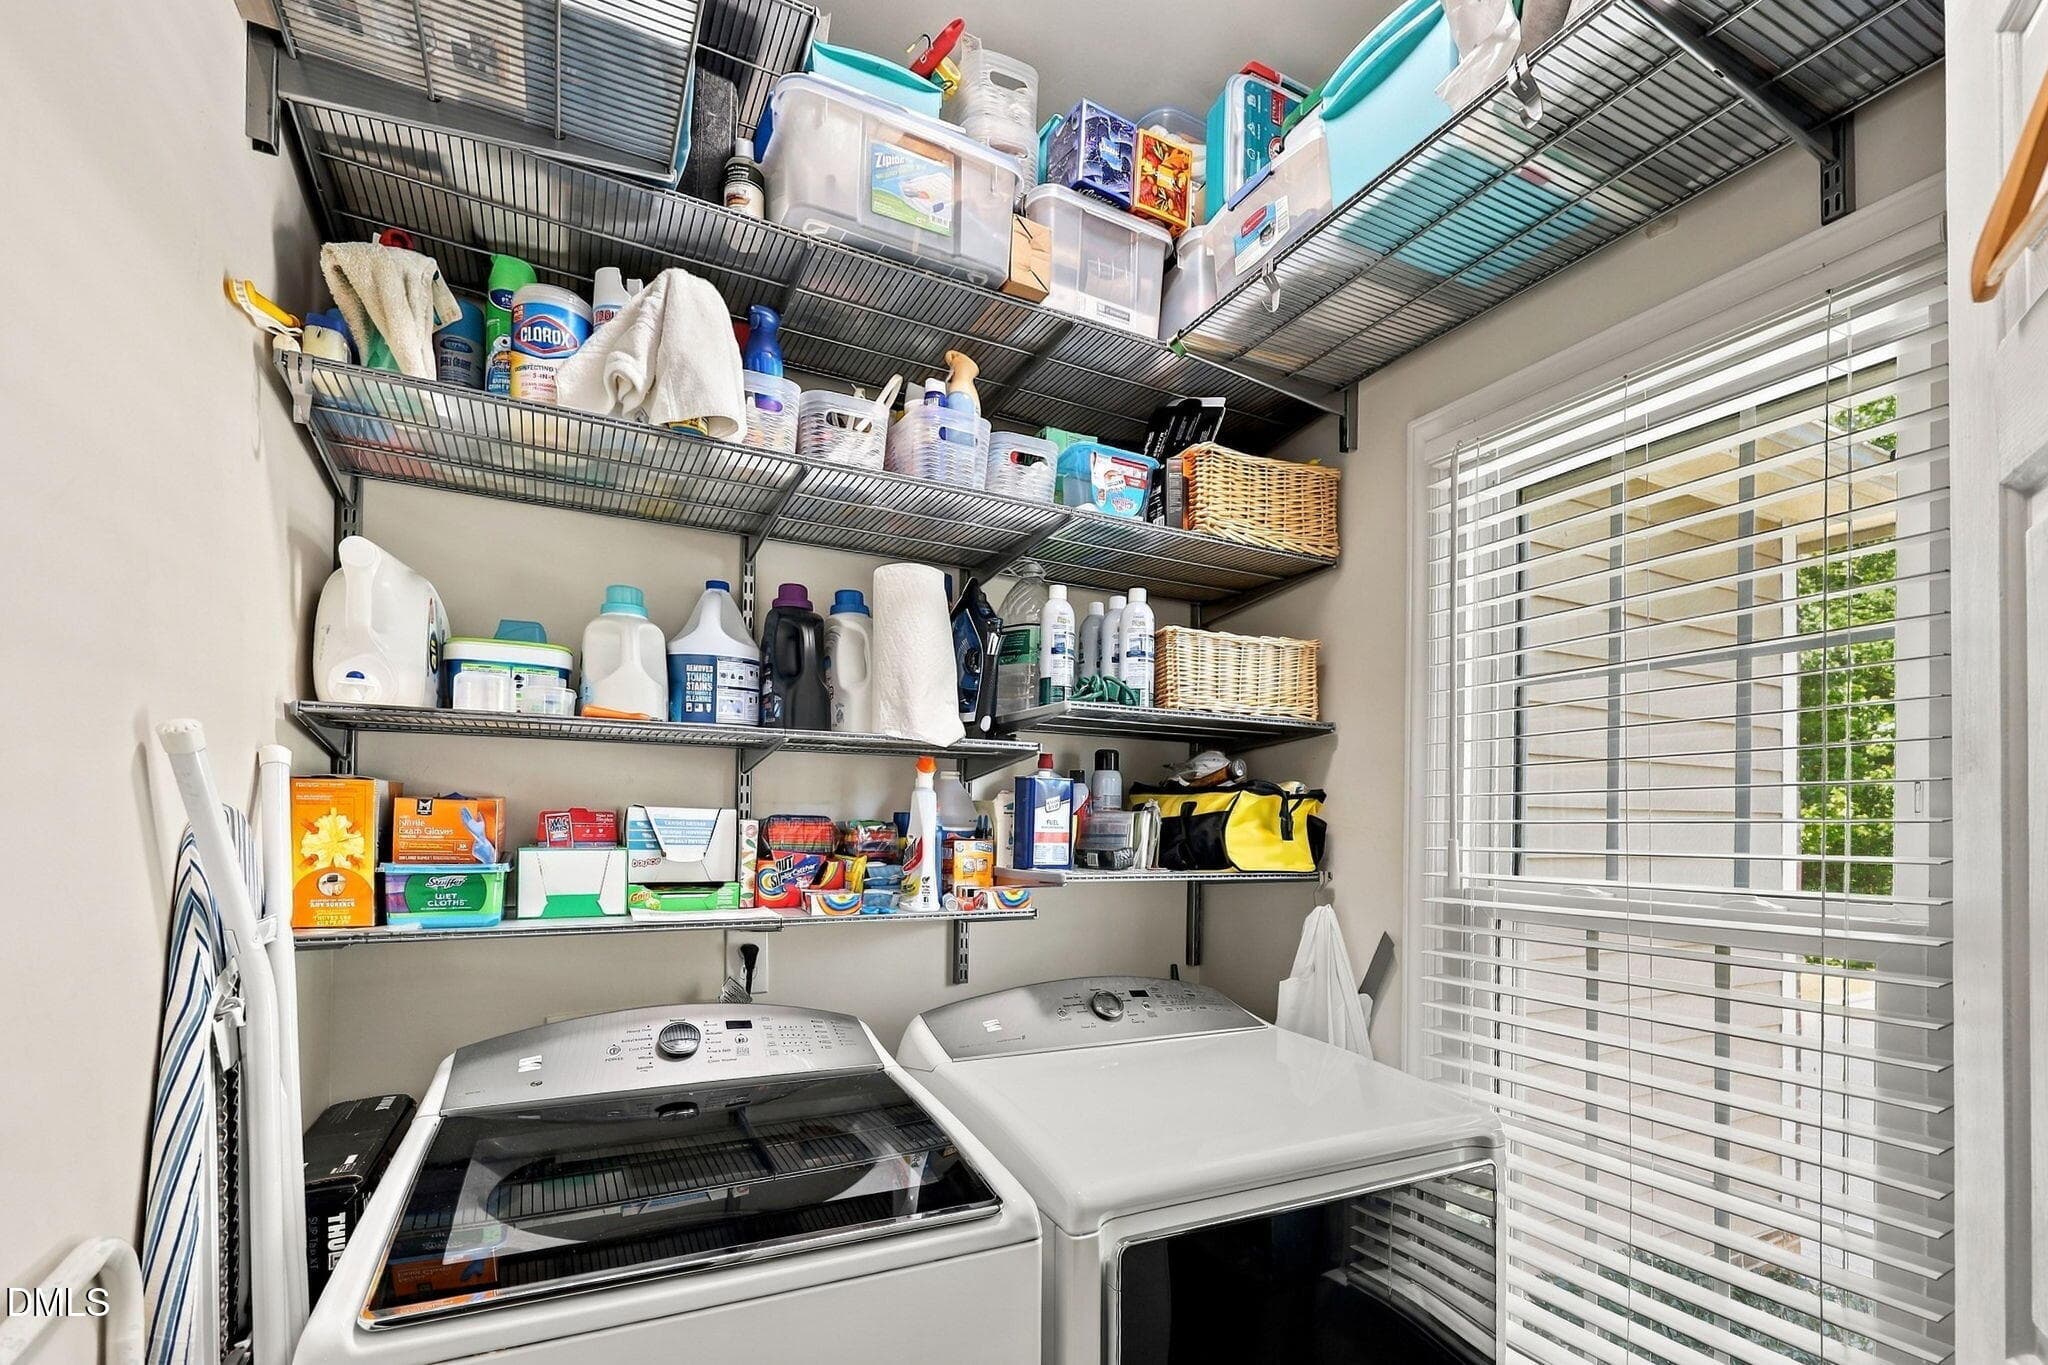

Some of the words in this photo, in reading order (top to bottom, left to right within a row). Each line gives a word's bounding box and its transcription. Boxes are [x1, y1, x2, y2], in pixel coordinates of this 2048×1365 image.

[874, 151, 905, 168] Ziploc
[520, 326, 570, 348] CLOROX
[686, 672, 713, 682] TOUGH
[686, 681, 713, 691] STAINS
[424, 826, 454, 836] Gloves
[426, 876, 466, 888] Swiffer
[427, 899, 465, 907] CLOTHS
